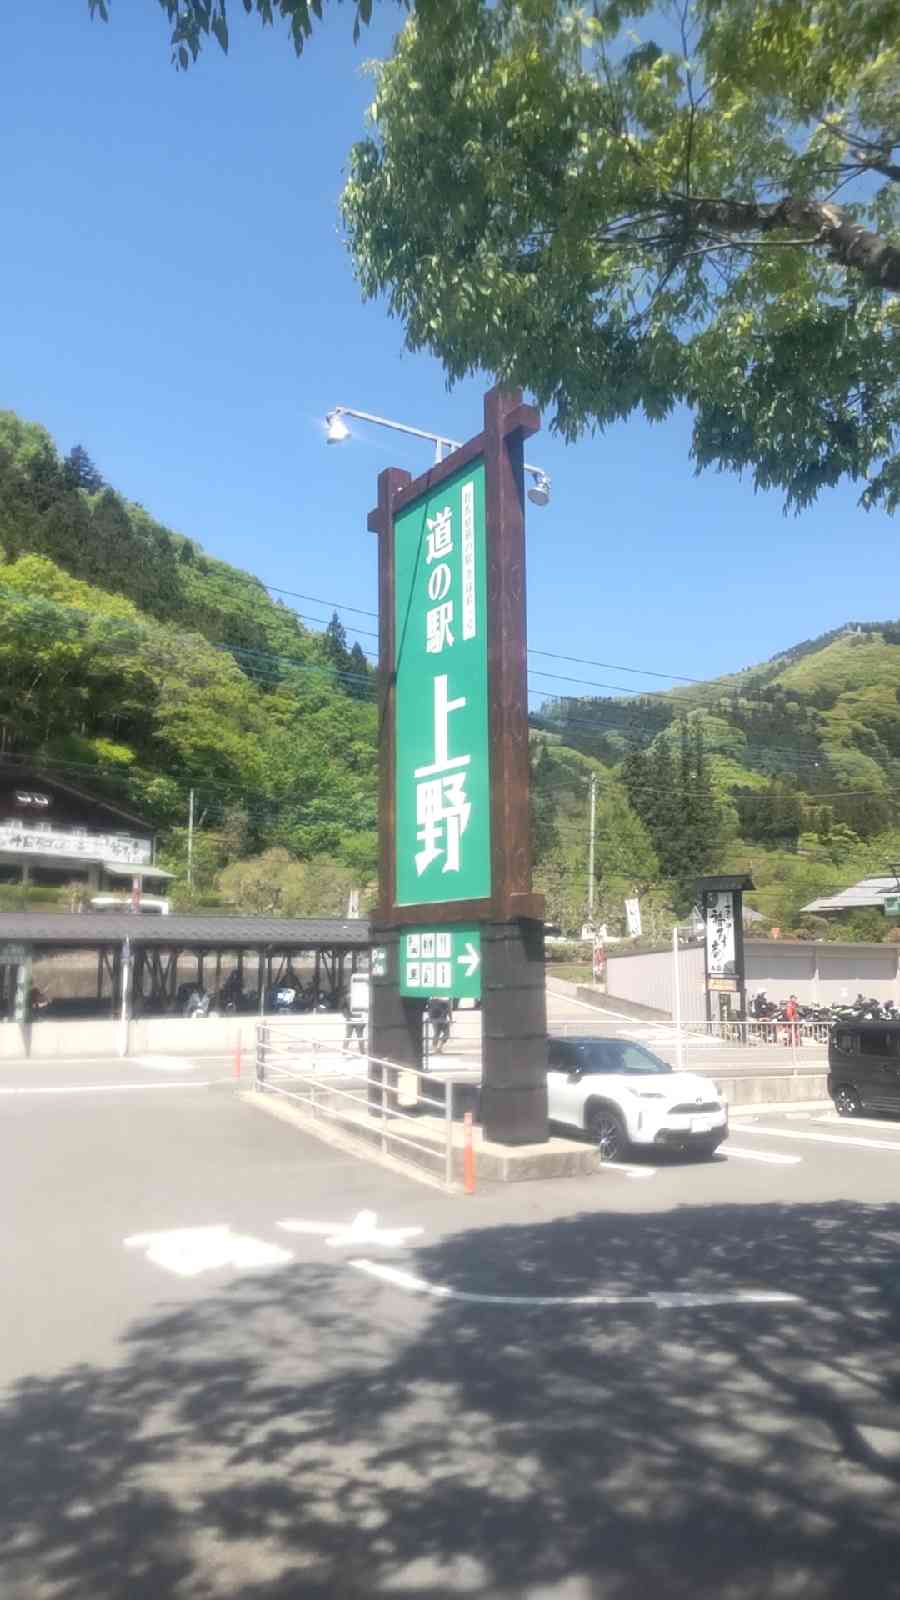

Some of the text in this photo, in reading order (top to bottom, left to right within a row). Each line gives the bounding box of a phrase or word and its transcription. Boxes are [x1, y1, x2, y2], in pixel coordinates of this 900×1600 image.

[414, 506, 472, 878] 道の駅 上野
